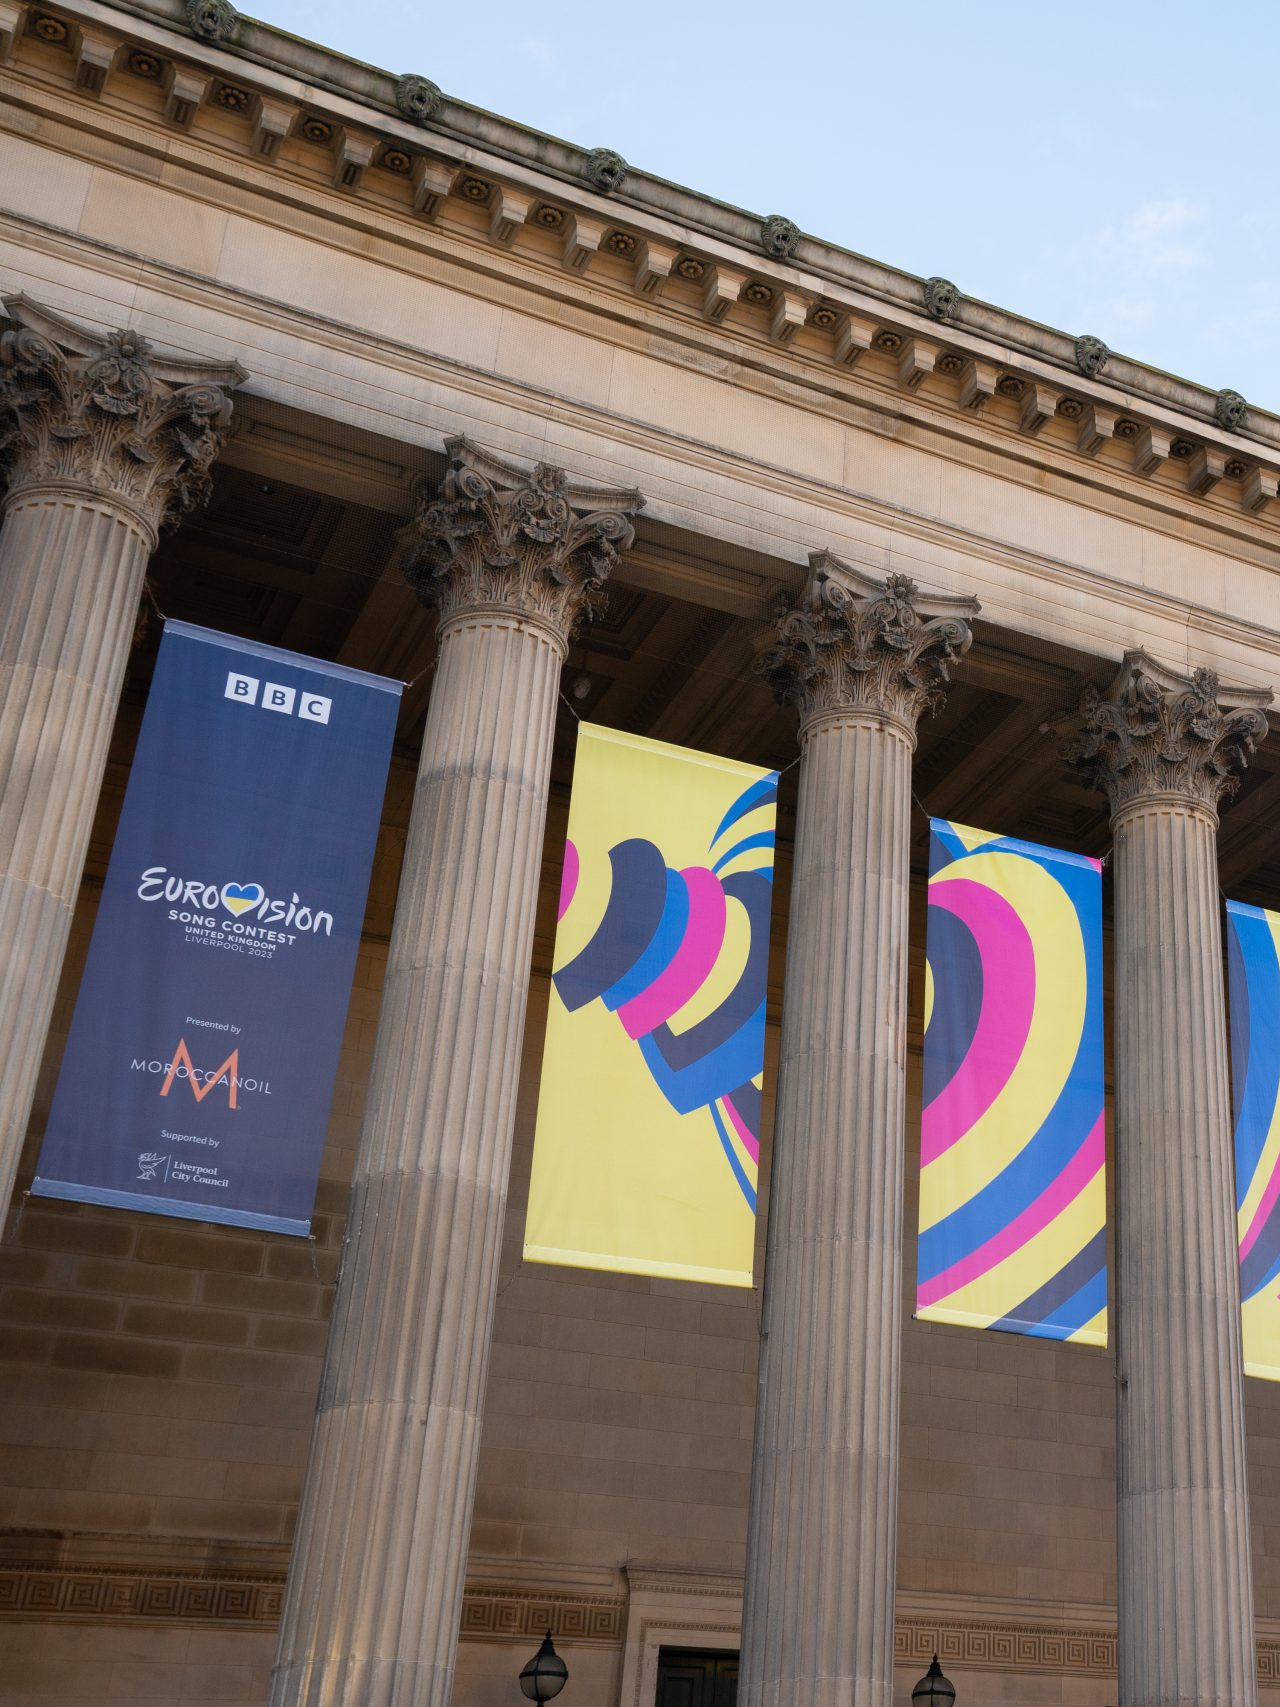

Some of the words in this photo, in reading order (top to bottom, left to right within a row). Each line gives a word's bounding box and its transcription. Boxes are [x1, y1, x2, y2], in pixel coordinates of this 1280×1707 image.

[231, 678, 325, 718] BBC
[168, 909, 216, 928] SONG
[221, 920, 297, 946] CONTEST
[184, 925, 225, 940] UNITED
[227, 934, 277, 951] KINGDOM
[184, 934, 245, 953] LIVERPOOL
[247, 947, 274, 959] 2023
[185, 1016, 230, 1031] Presented
[230, 1024, 242, 1035] by
[130, 1058, 272, 1095] MOROCCANOIL
[160, 1129, 208, 1145] Supported
[208, 1138, 220, 1149] by
[171, 1171, 192, 1183] City
[192, 1175, 229, 1188] Council
[173, 1161, 218, 1176] Liverpool
